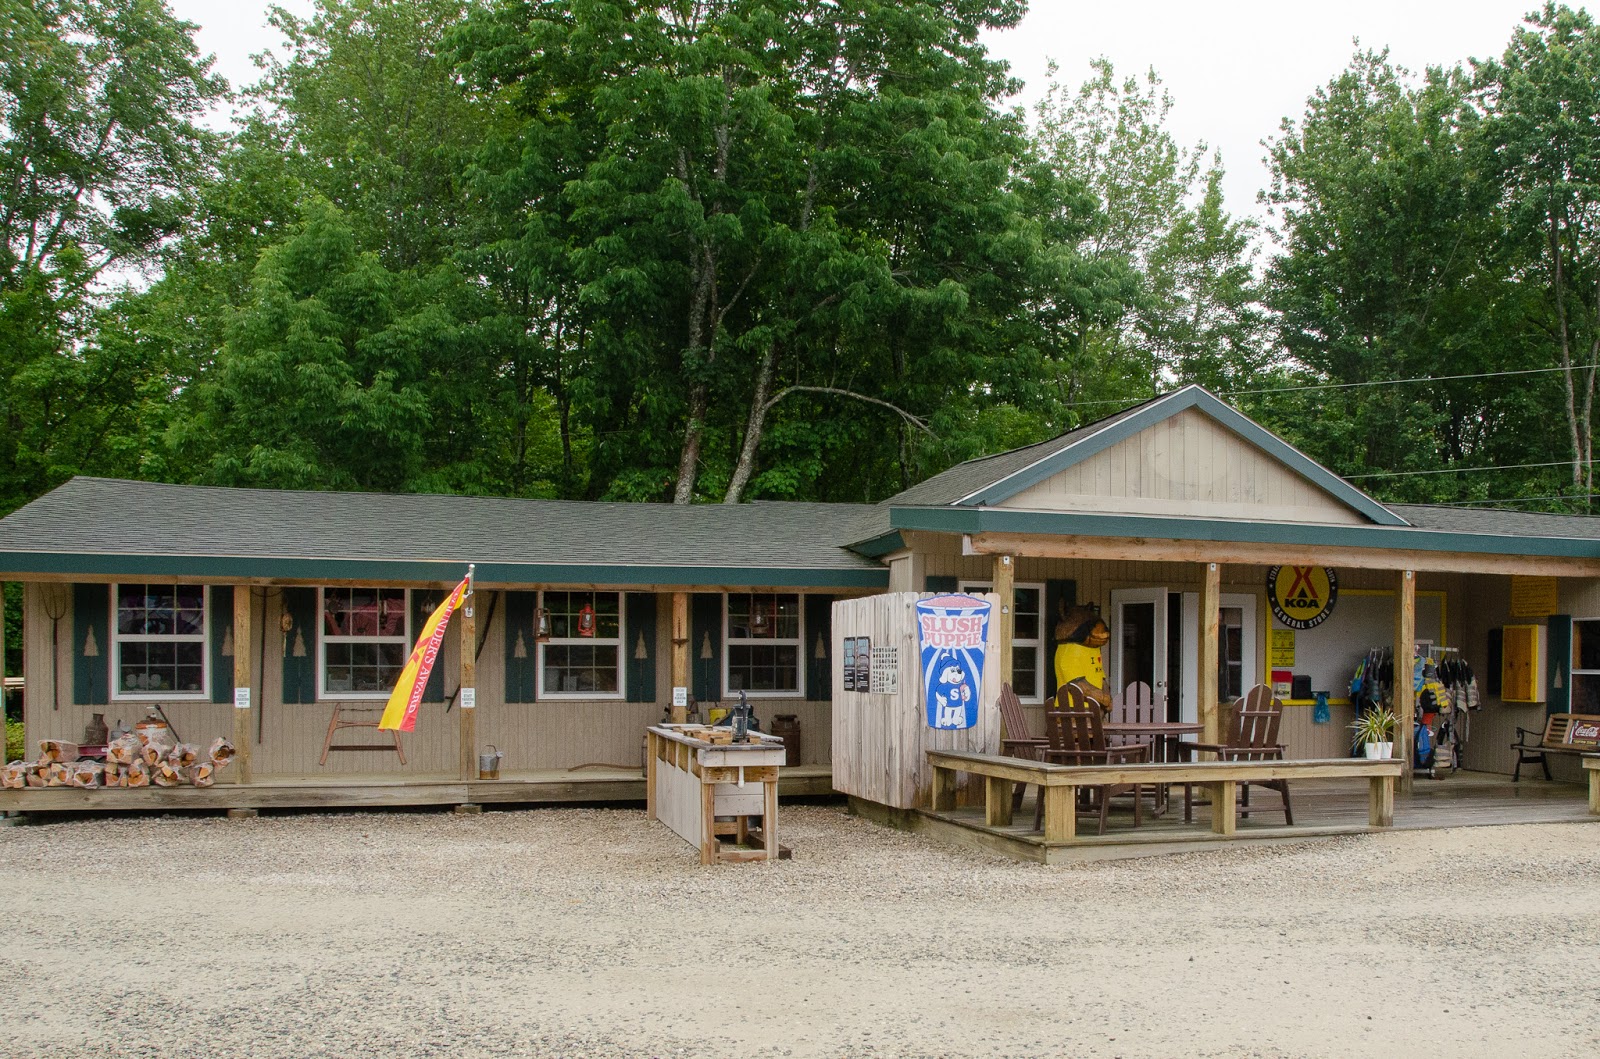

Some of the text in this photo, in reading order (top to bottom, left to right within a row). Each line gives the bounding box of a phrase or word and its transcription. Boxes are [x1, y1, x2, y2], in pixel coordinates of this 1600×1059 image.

[1284, 598, 1320, 609] KOA
[921, 615, 983, 633] SLUSH
[1274, 606, 1330, 629] GENERAL STORE
[408, 665, 430, 714] AWARD
[949, 688, 960, 701] S
